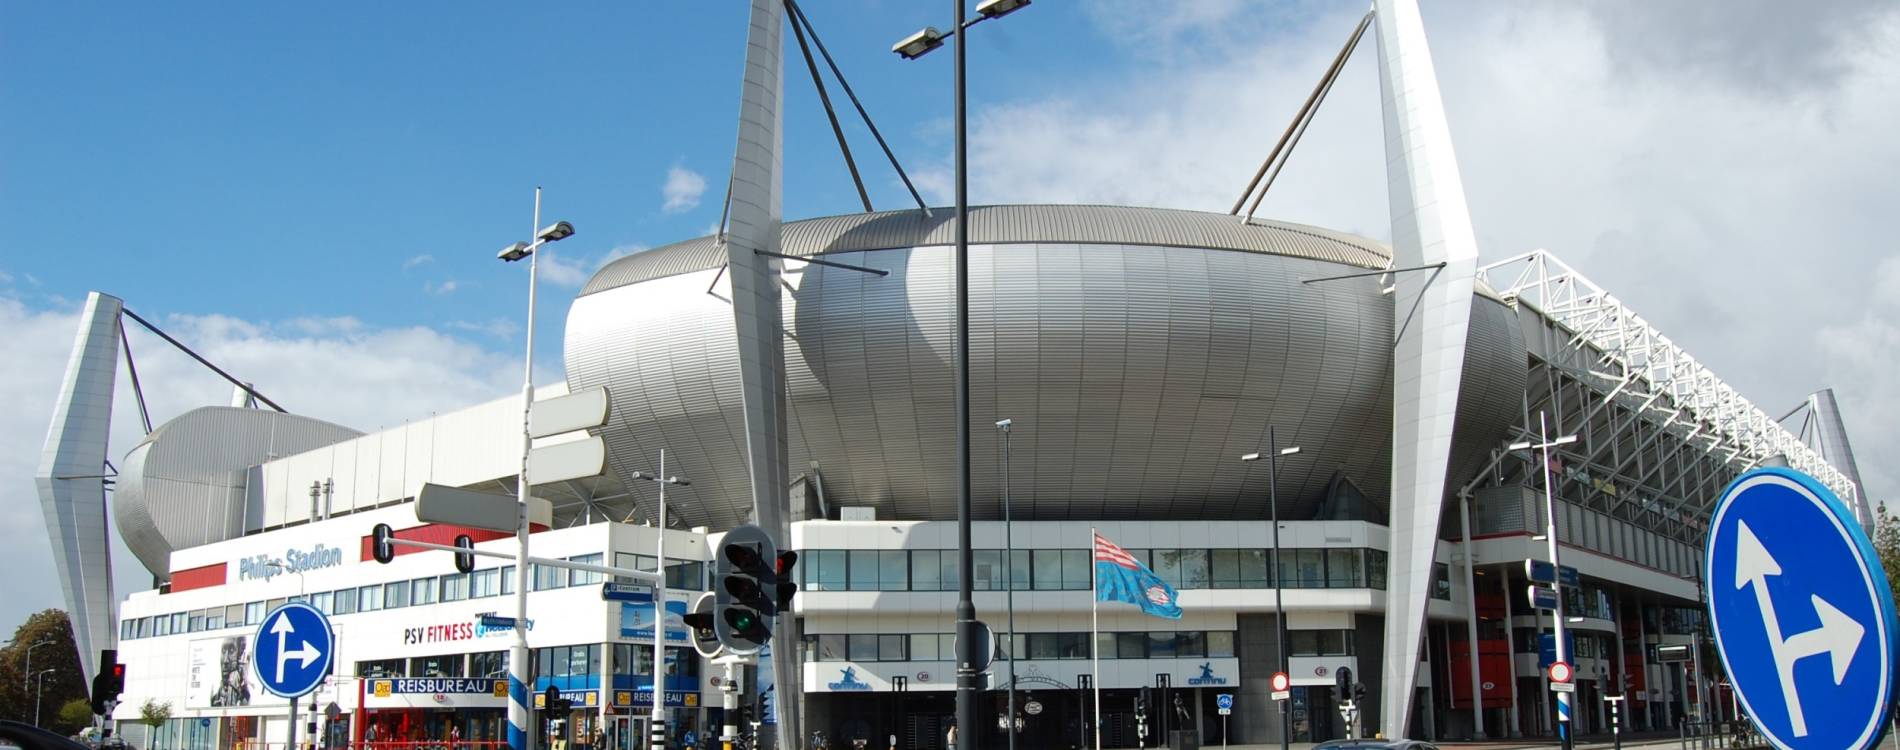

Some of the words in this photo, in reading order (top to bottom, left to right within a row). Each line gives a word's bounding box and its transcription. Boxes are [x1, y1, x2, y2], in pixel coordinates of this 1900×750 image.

[240, 554, 282, 582] Philips
[286, 543, 342, 574] Stadion
[404, 628, 424, 645] PSV
[427, 622, 473, 643] FITNESS
[398, 680, 487, 693] REISBUREAU
